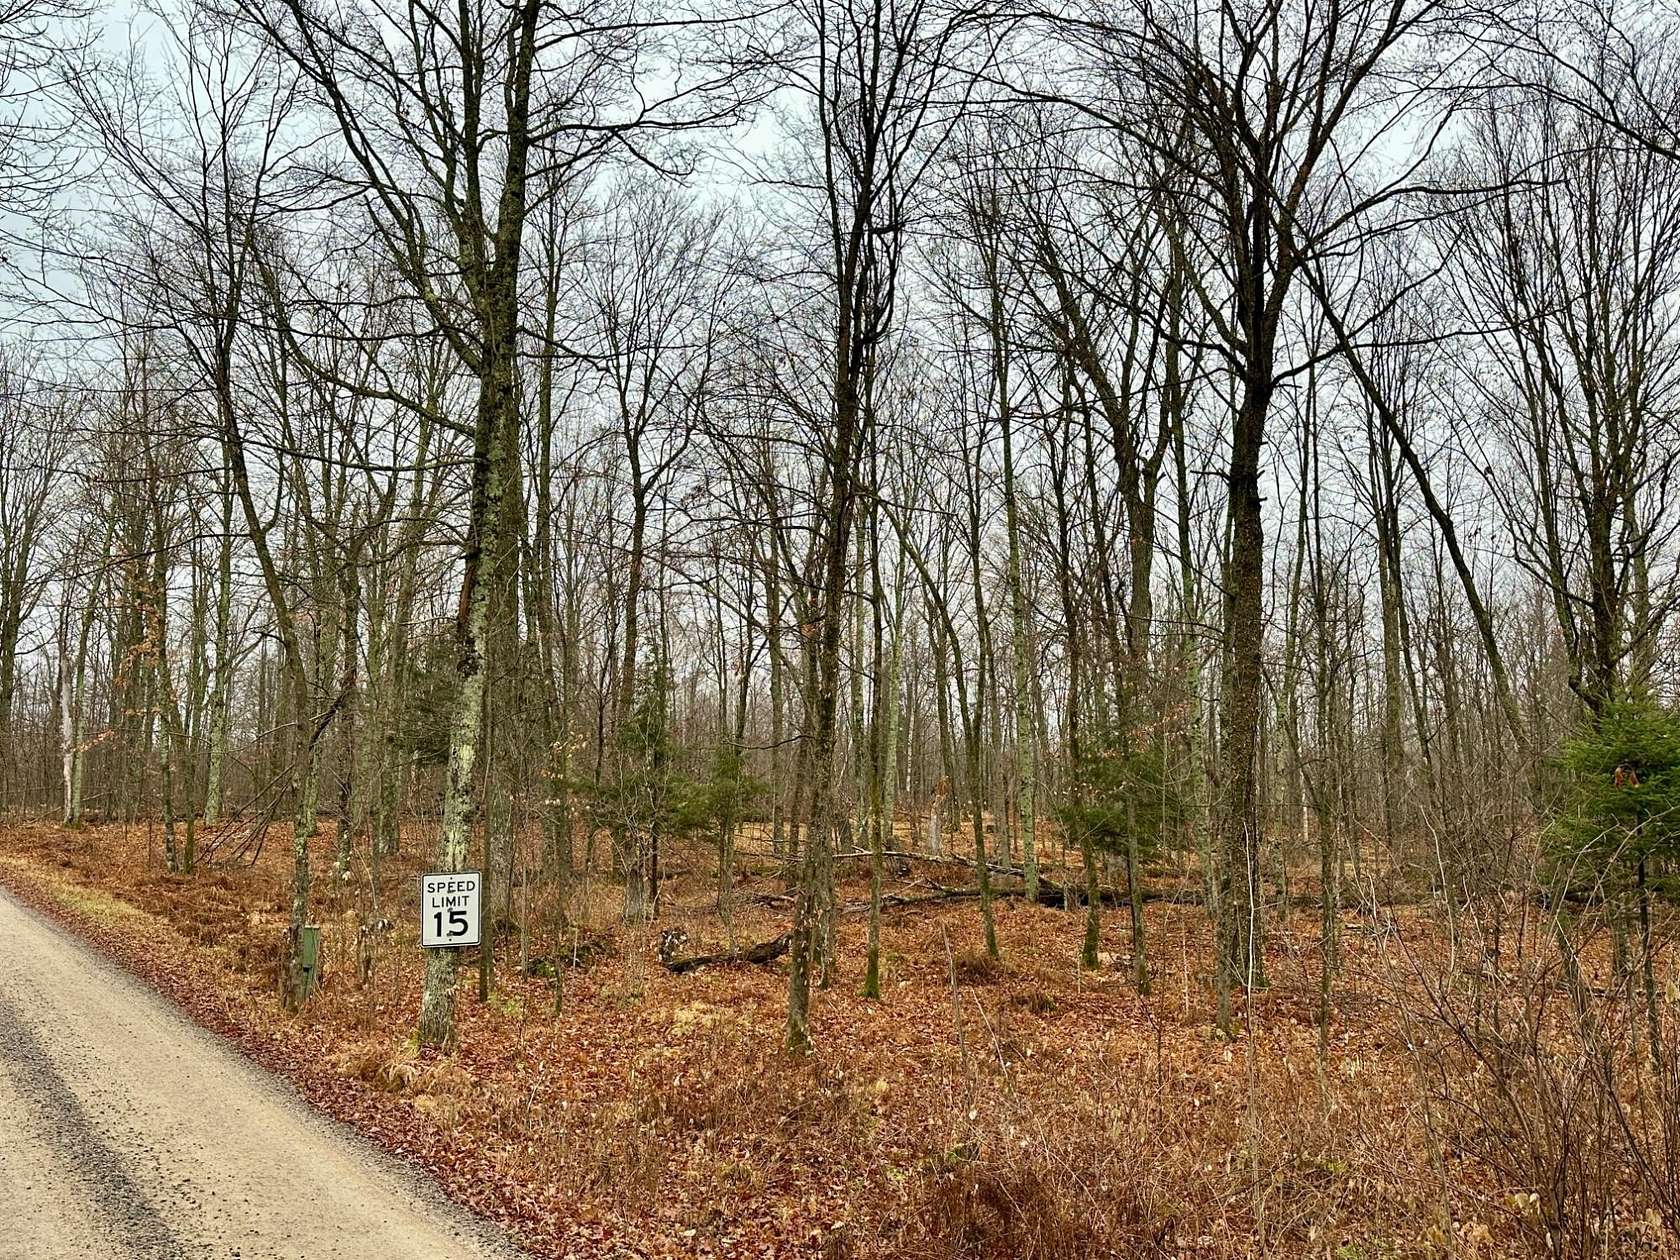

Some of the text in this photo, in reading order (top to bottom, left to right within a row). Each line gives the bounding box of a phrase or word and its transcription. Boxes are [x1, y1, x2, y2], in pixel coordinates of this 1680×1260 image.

[427, 880, 476, 893] SPEED
[432, 895, 470, 908] LIMIT
[433, 910, 469, 937] 15
